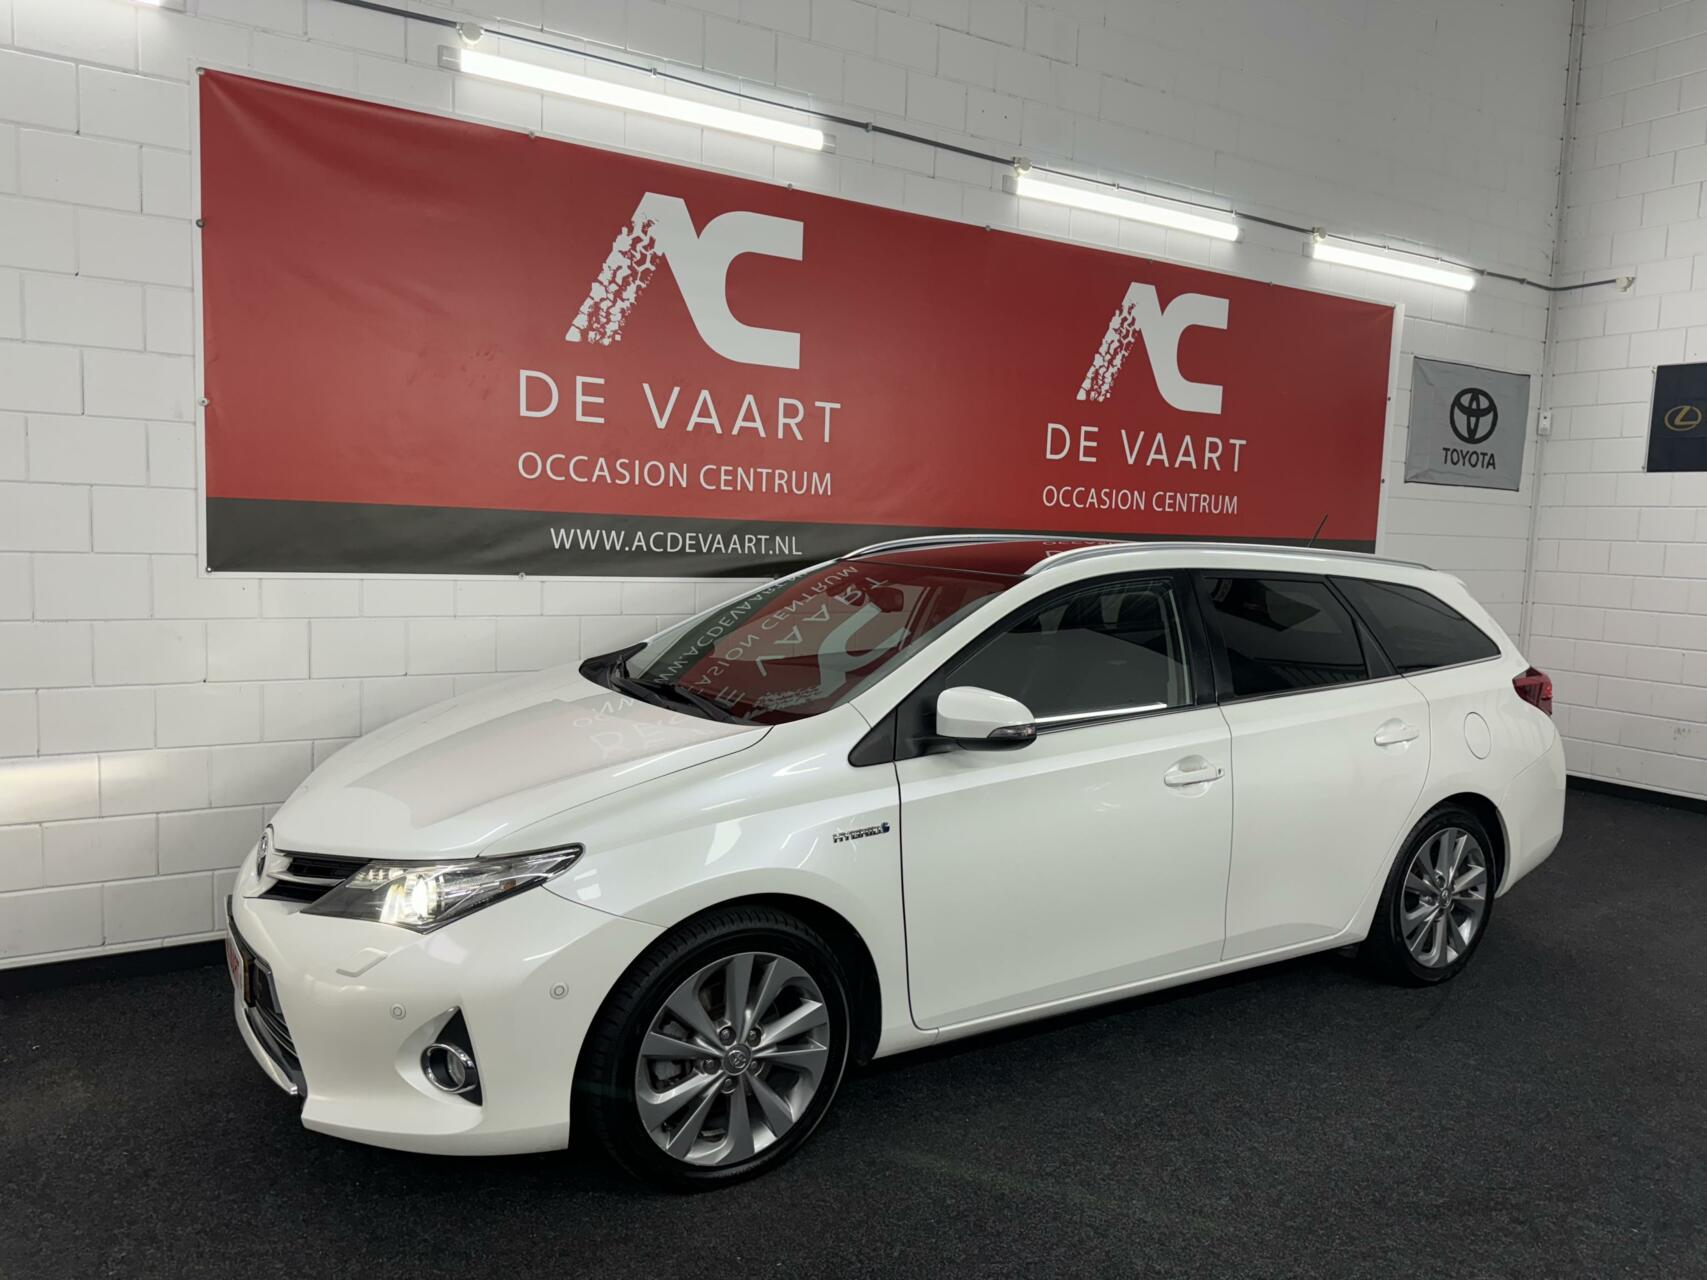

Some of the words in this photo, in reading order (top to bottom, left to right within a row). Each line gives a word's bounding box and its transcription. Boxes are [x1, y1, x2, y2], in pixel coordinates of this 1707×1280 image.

[519, 369, 605, 424] DE
[642, 382, 841, 443] VAART
[1045, 422, 1099, 463] DE
[1120, 429, 1247, 473] VAART
[1442, 447, 1497, 470] TOYOTA
[517, 451, 688, 488] OCCASION
[699, 464, 832, 496] CENTRUM
[1042, 485, 1146, 511] OCCASION
[1152, 491, 1238, 515] CENTRUM
[550, 527, 803, 556] WWW.ACDEVAART.NL
